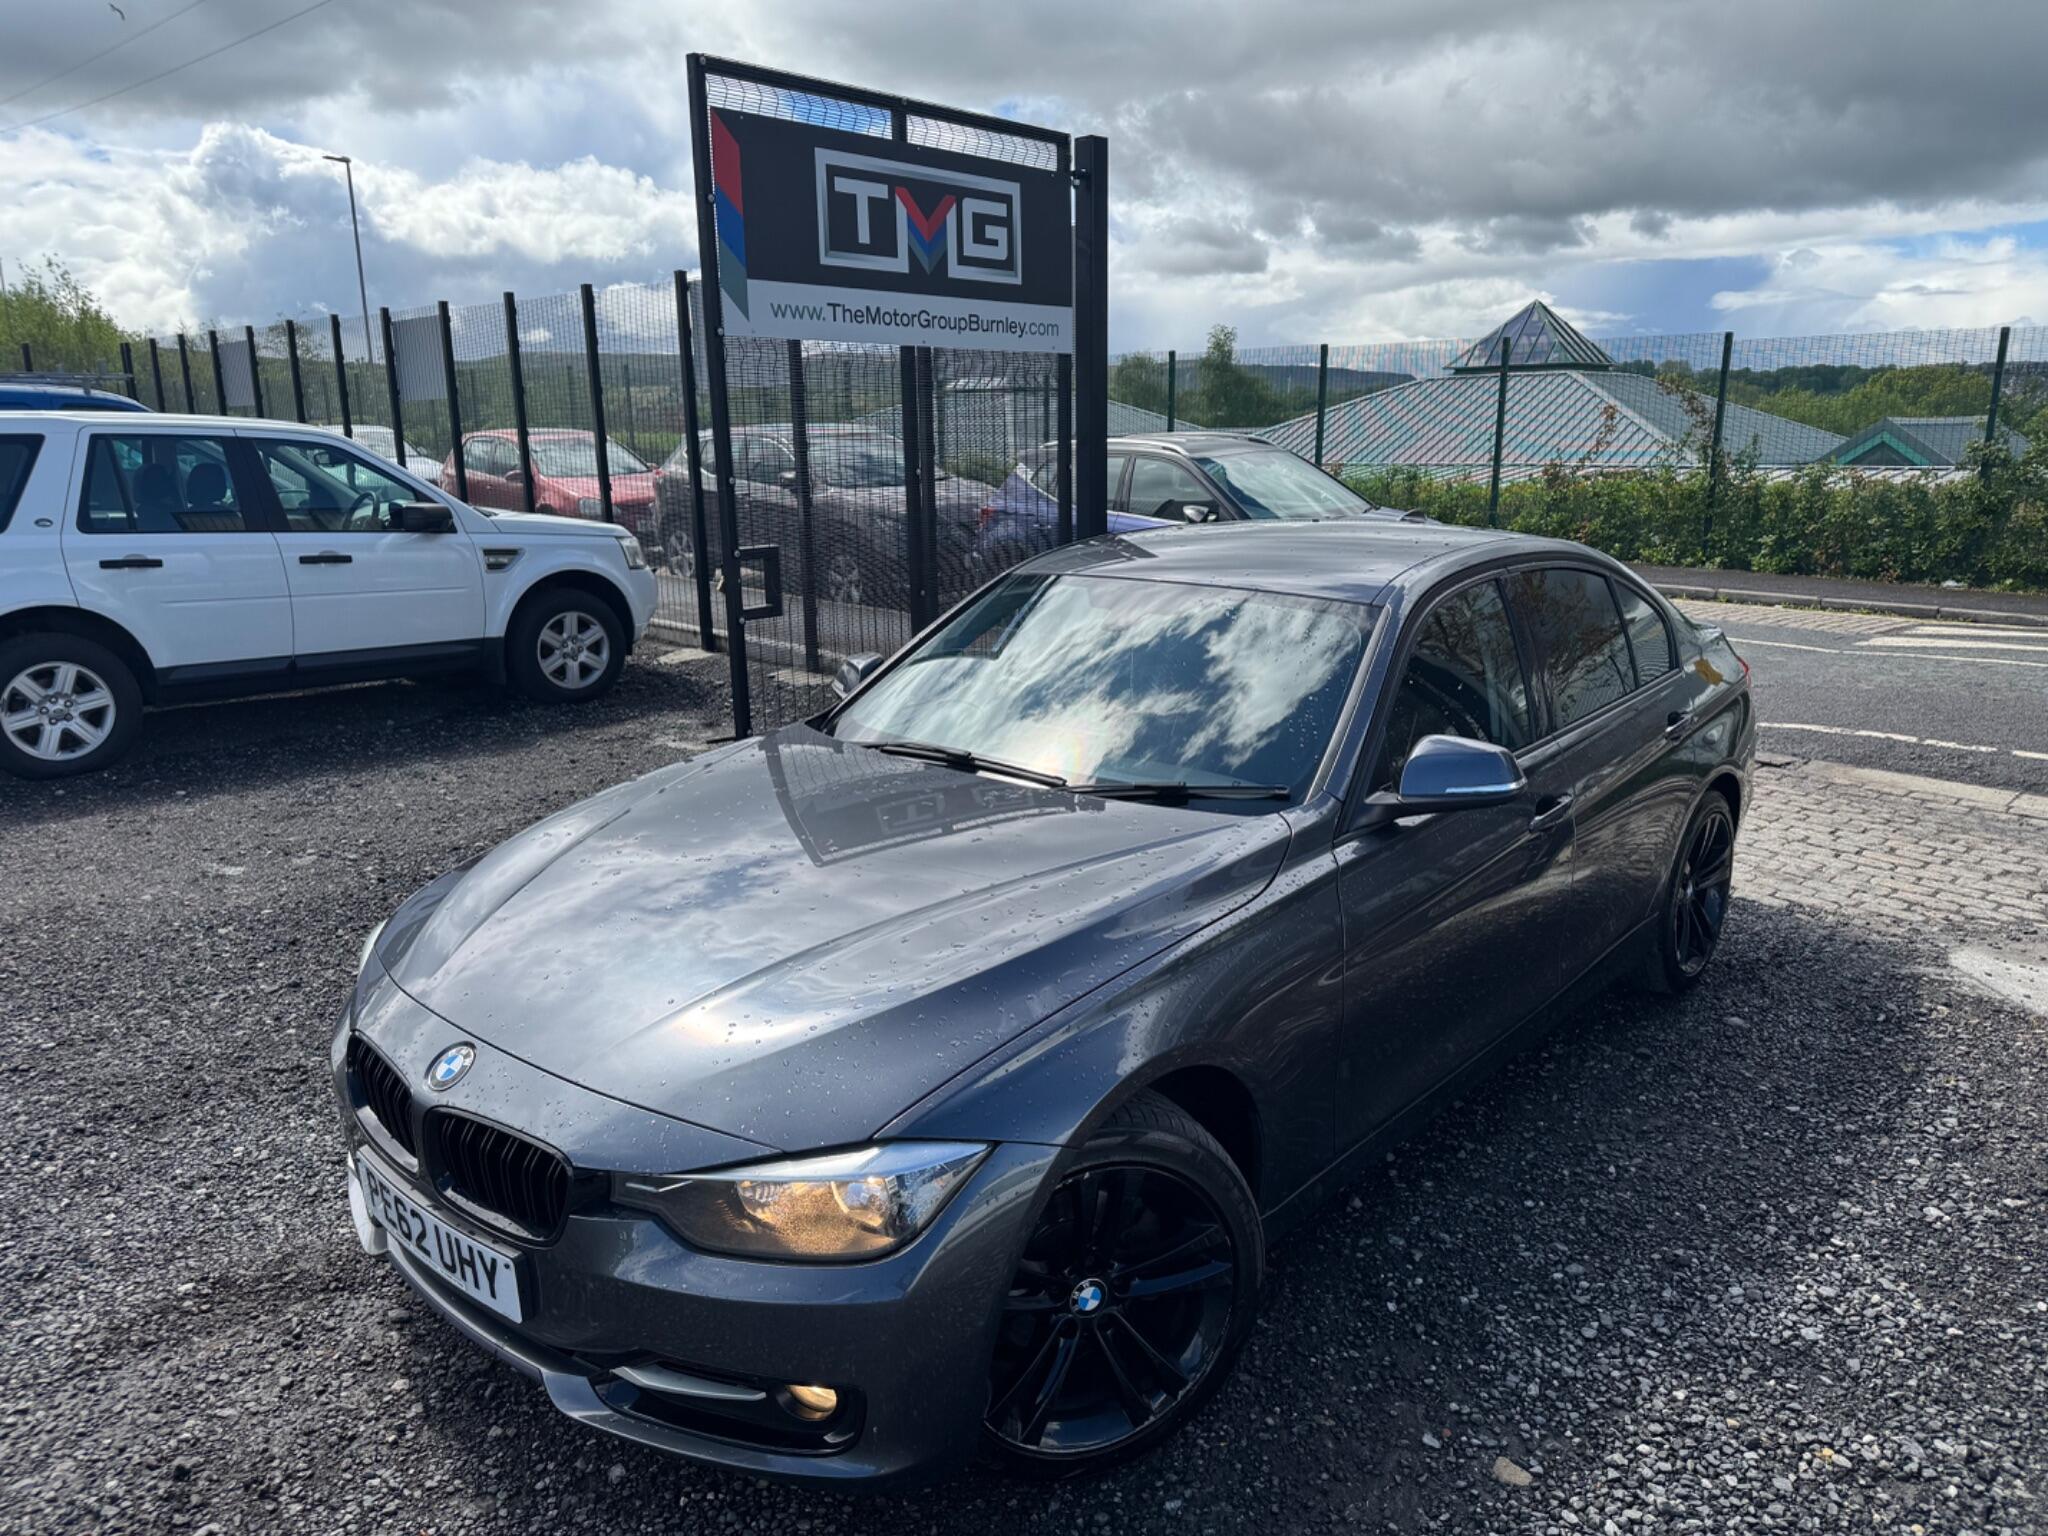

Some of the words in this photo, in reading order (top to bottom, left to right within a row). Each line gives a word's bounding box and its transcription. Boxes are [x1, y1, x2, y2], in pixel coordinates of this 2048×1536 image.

[834, 176, 1008, 276] TMG
[769, 302, 1060, 338] www.TheMotorGroupBurnley.com
[365, 1166, 431, 1259] PE62
[434, 1223, 497, 1300] UHY
